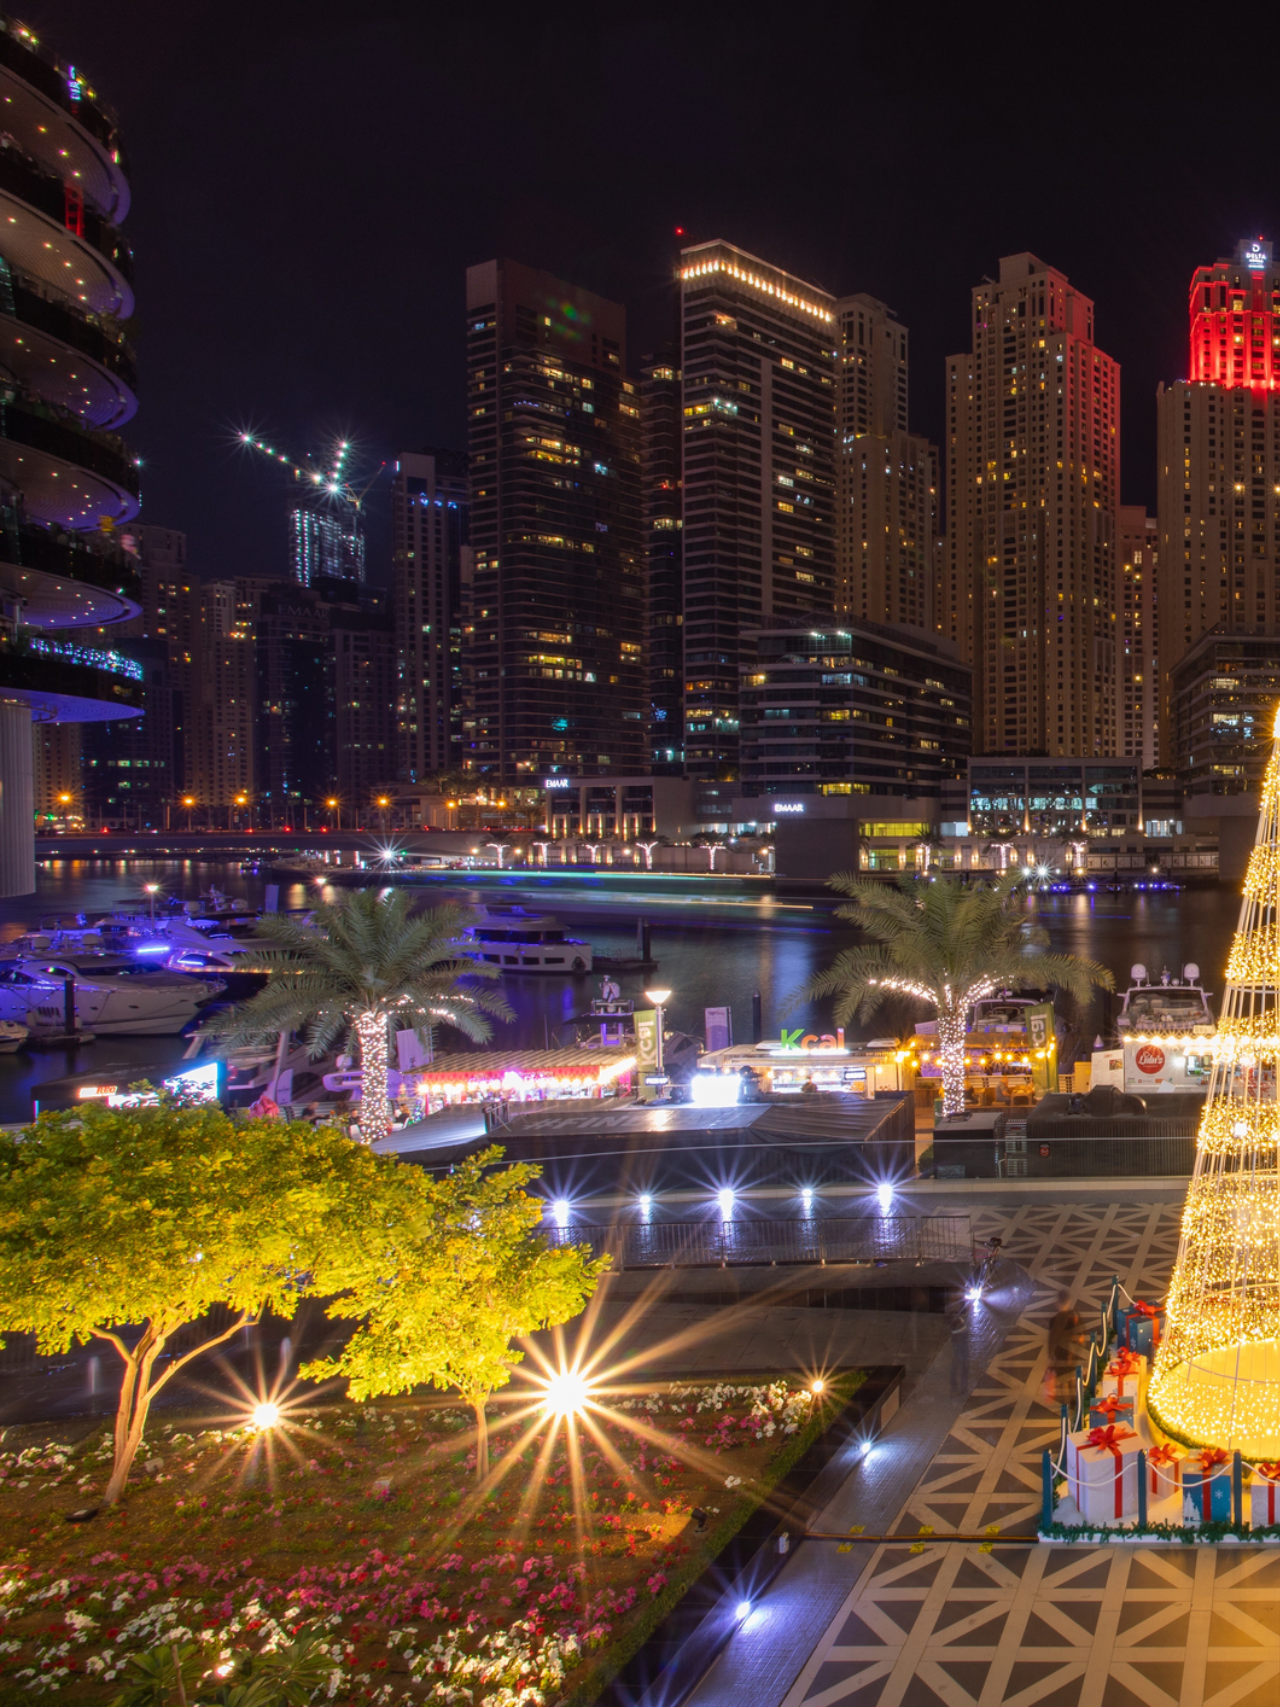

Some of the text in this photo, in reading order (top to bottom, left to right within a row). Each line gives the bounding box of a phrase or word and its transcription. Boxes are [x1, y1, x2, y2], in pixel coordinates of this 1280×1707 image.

[1246, 252, 1267, 260] DELTA
[277, 603, 329, 620] EMAAR
[545, 779, 568, 788] EMAAR
[774, 803, 804, 812] EMAAR
[781, 1027, 845, 1051] Kcal
